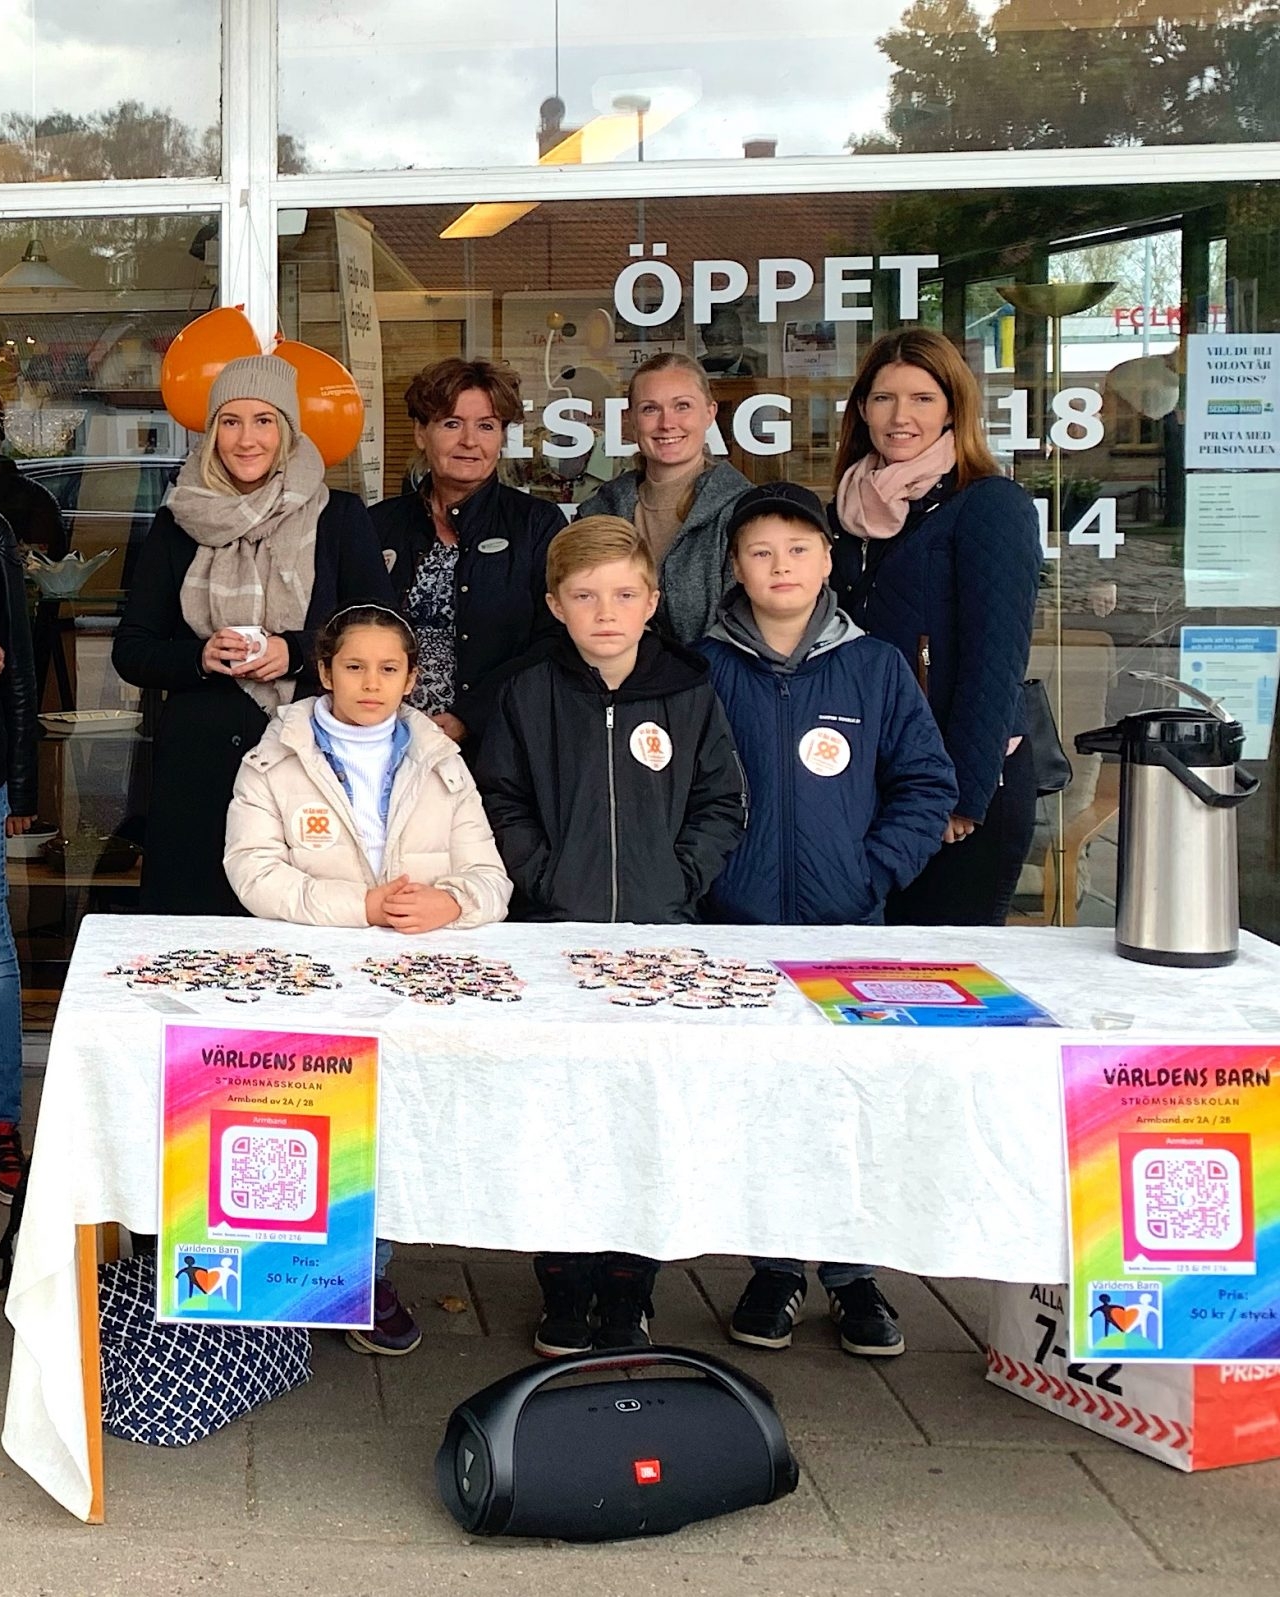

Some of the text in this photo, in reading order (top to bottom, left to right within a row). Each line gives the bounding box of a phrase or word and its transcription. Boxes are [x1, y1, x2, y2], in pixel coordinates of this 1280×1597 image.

[614, 243, 939, 327] ÖPPET
[1207, 346, 1272, 356] VILL DU BLI
[1207, 359, 1271, 370] VOLONTÄR
[1210, 375, 1267, 384] HOS OSS?
[1203, 431, 1271, 440] PRATA MED
[1199, 445, 1275, 455] PERSONALEN
[201, 1044, 353, 1075] VÄRLDENS BARN
[1103, 1062, 1271, 1088] VÄRLDENS BARN
[215, 1076, 323, 1091] STRÖMSNÄSSKOLAN
[227, 1095, 268, 1105] Armband
[282, 1098, 294, 1106] 2A
[303, 1099, 314, 1107] 2B
[1121, 1095, 1240, 1106] STRÖMSNÄSSKOLAN
[252, 1116, 287, 1125] Armband
[1136, 1115, 1181, 1124] Armband
[1196, 1116, 1209, 1124] 2A
[1220, 1116, 1231, 1124] 2B
[178, 1243, 240, 1254] Världens Barn
[292, 1255, 320, 1267] Pris:
[266, 1273, 345, 1289] 50 kr / styck
[1092, 1281, 1160, 1290] Världens Barn
[1030, 1284, 1064, 1315] ALLA
[1218, 1289, 1249, 1300] Pris:
[1190, 1308, 1277, 1324] 50 kr / styck
